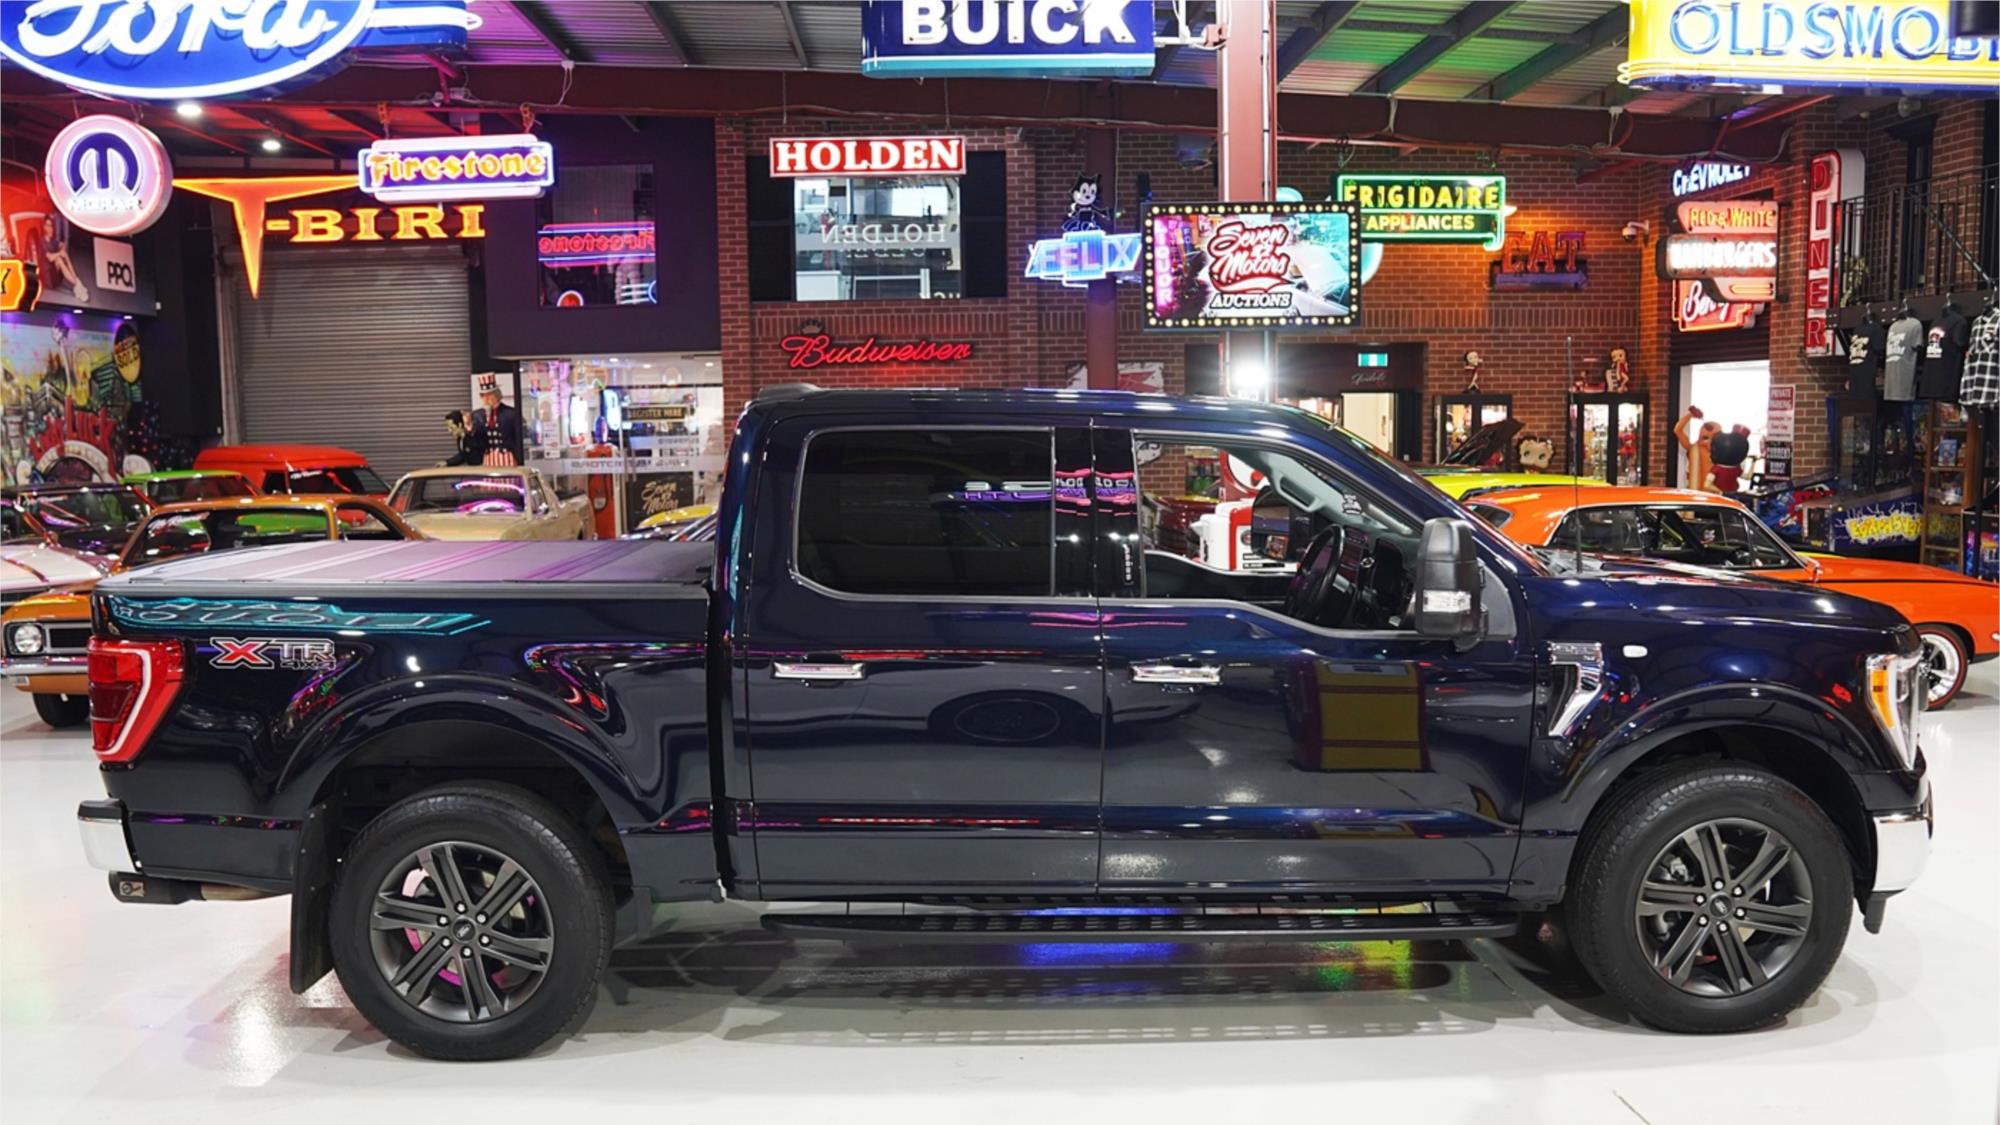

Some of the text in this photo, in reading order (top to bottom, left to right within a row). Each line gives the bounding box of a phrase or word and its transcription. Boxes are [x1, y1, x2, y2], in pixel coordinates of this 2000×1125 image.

[902, 0, 1137, 45] BUICK
[369, 147, 547, 183] Firestone
[775, 139, 961, 172] HOLDEN
[1343, 185, 1499, 210] FRIGIDAIRE
[1366, 215, 1475, 232] APPLIANCES
[1690, 207, 1718, 228] RED
[1729, 207, 1775, 228] WHITE
[1038, 237, 1136, 273] FELIX
[1502, 231, 1587, 273] EAT
[1807, 162, 1833, 346] DINER
[107, 261, 134, 288] PPQ
[1211, 293, 1291, 308] AUCTIONS
[779, 334, 972, 369] Budweiser
[209, 637, 335, 669] XTR
